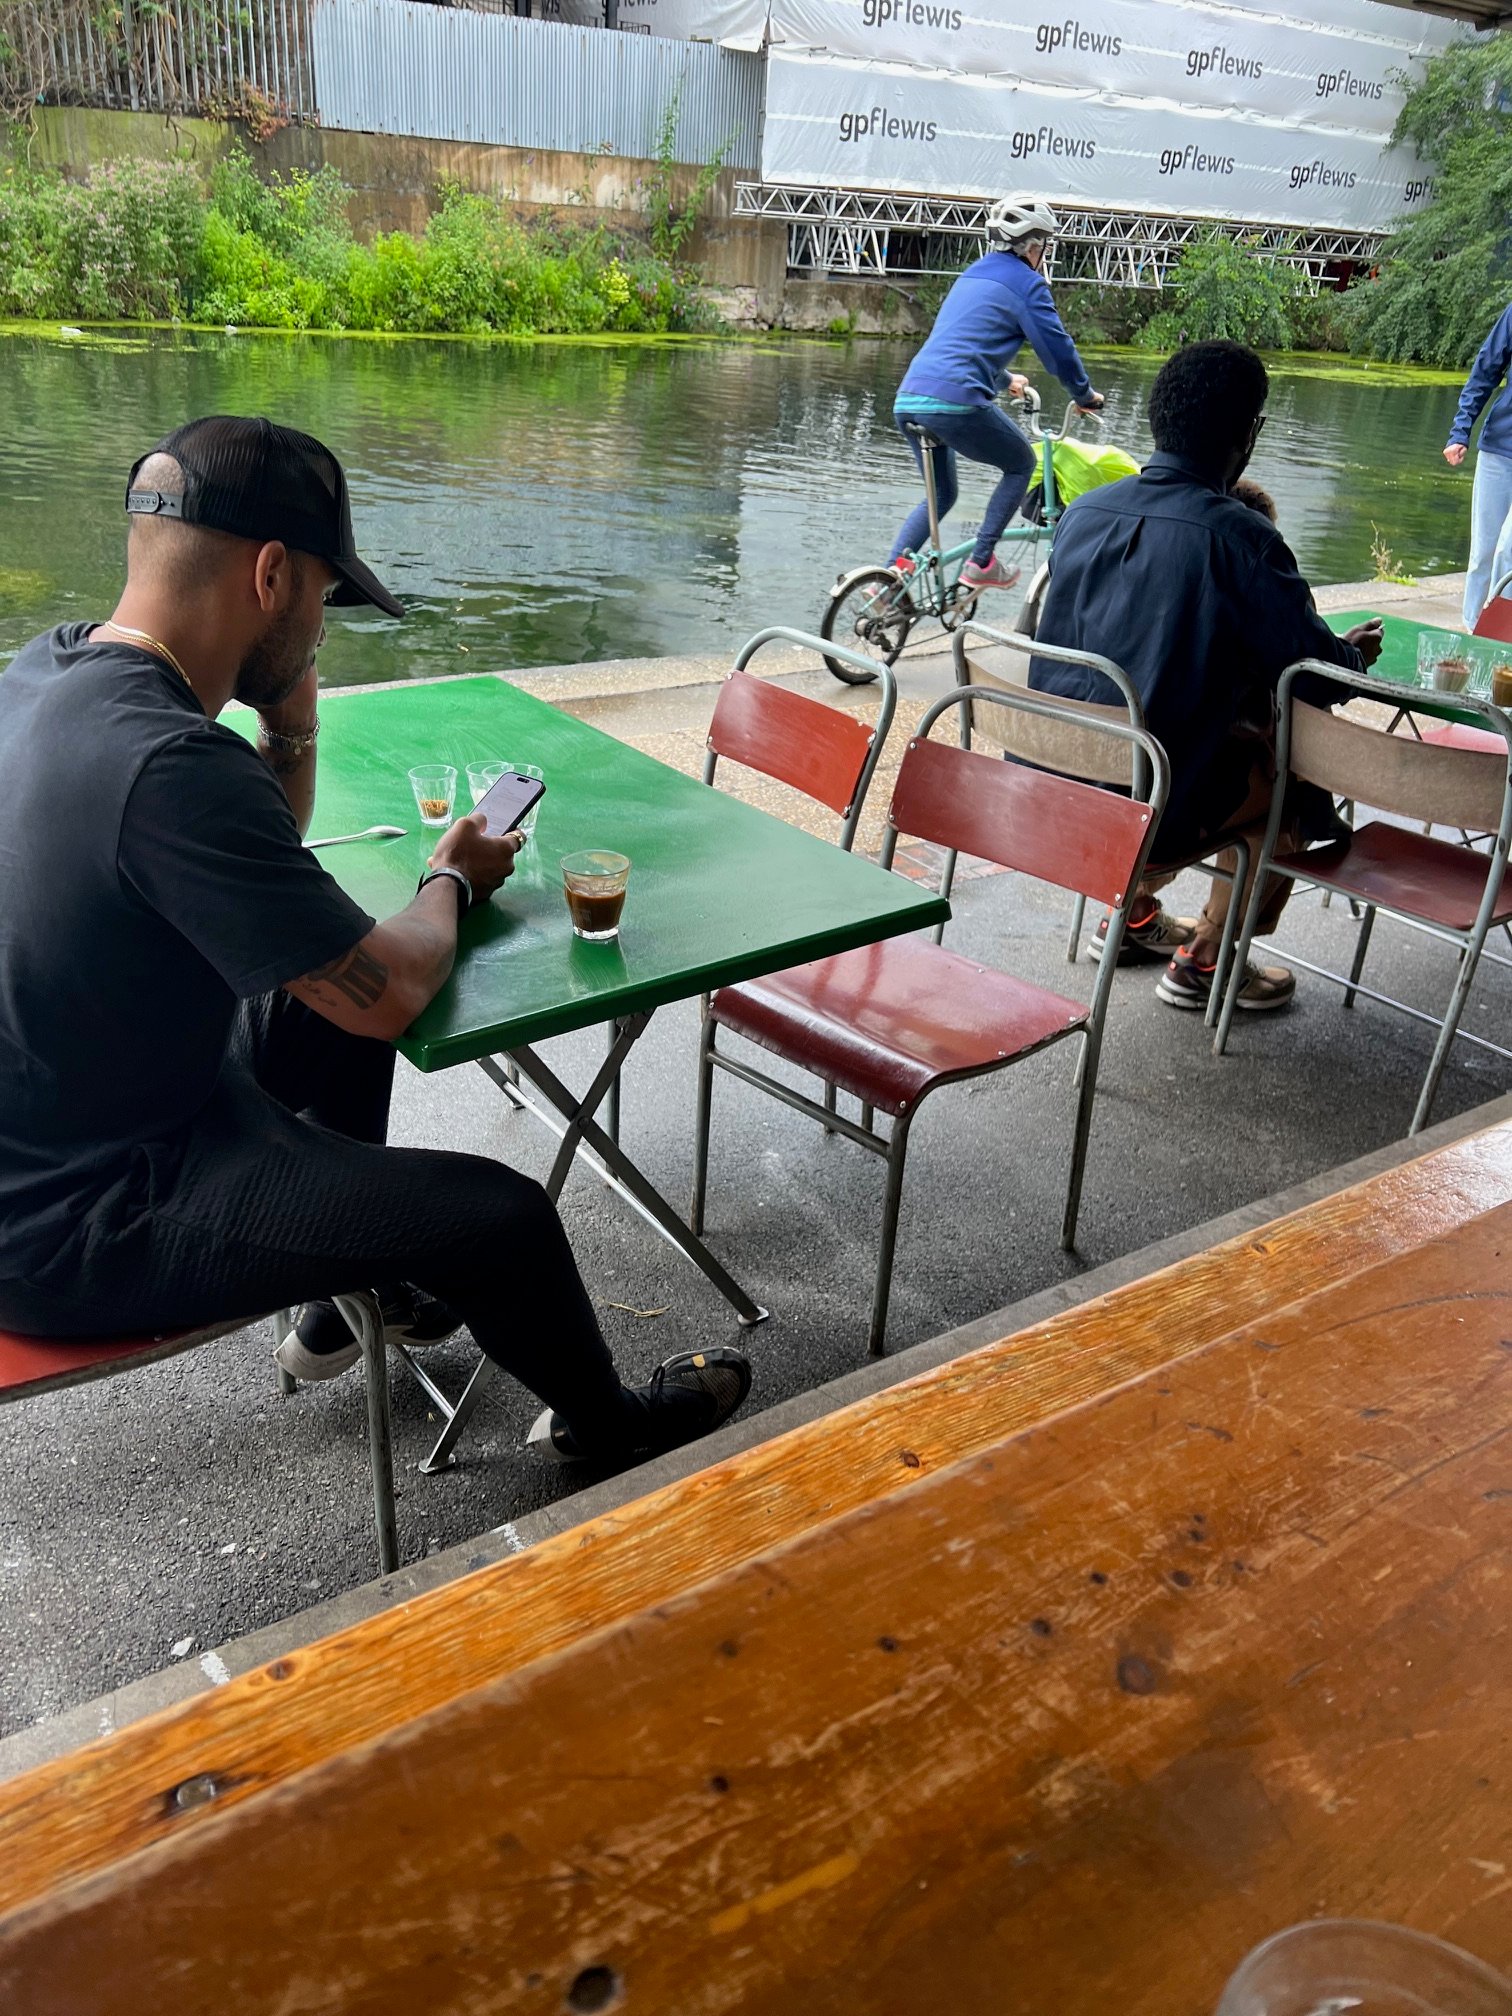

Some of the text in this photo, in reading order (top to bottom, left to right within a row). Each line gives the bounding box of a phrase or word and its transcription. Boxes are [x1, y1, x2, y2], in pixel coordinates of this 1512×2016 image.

[1035, 20, 1122, 56] gpflewis
[1186, 46, 1263, 79] gpflewis
[1316, 69, 1383, 100] gpflewis
[838, 107, 938, 142] gpflewis
[1010, 127, 1096, 160] gpflewis
[1159, 145, 1235, 175] gpflewis
[1289, 161, 1356, 189] gpflewis
